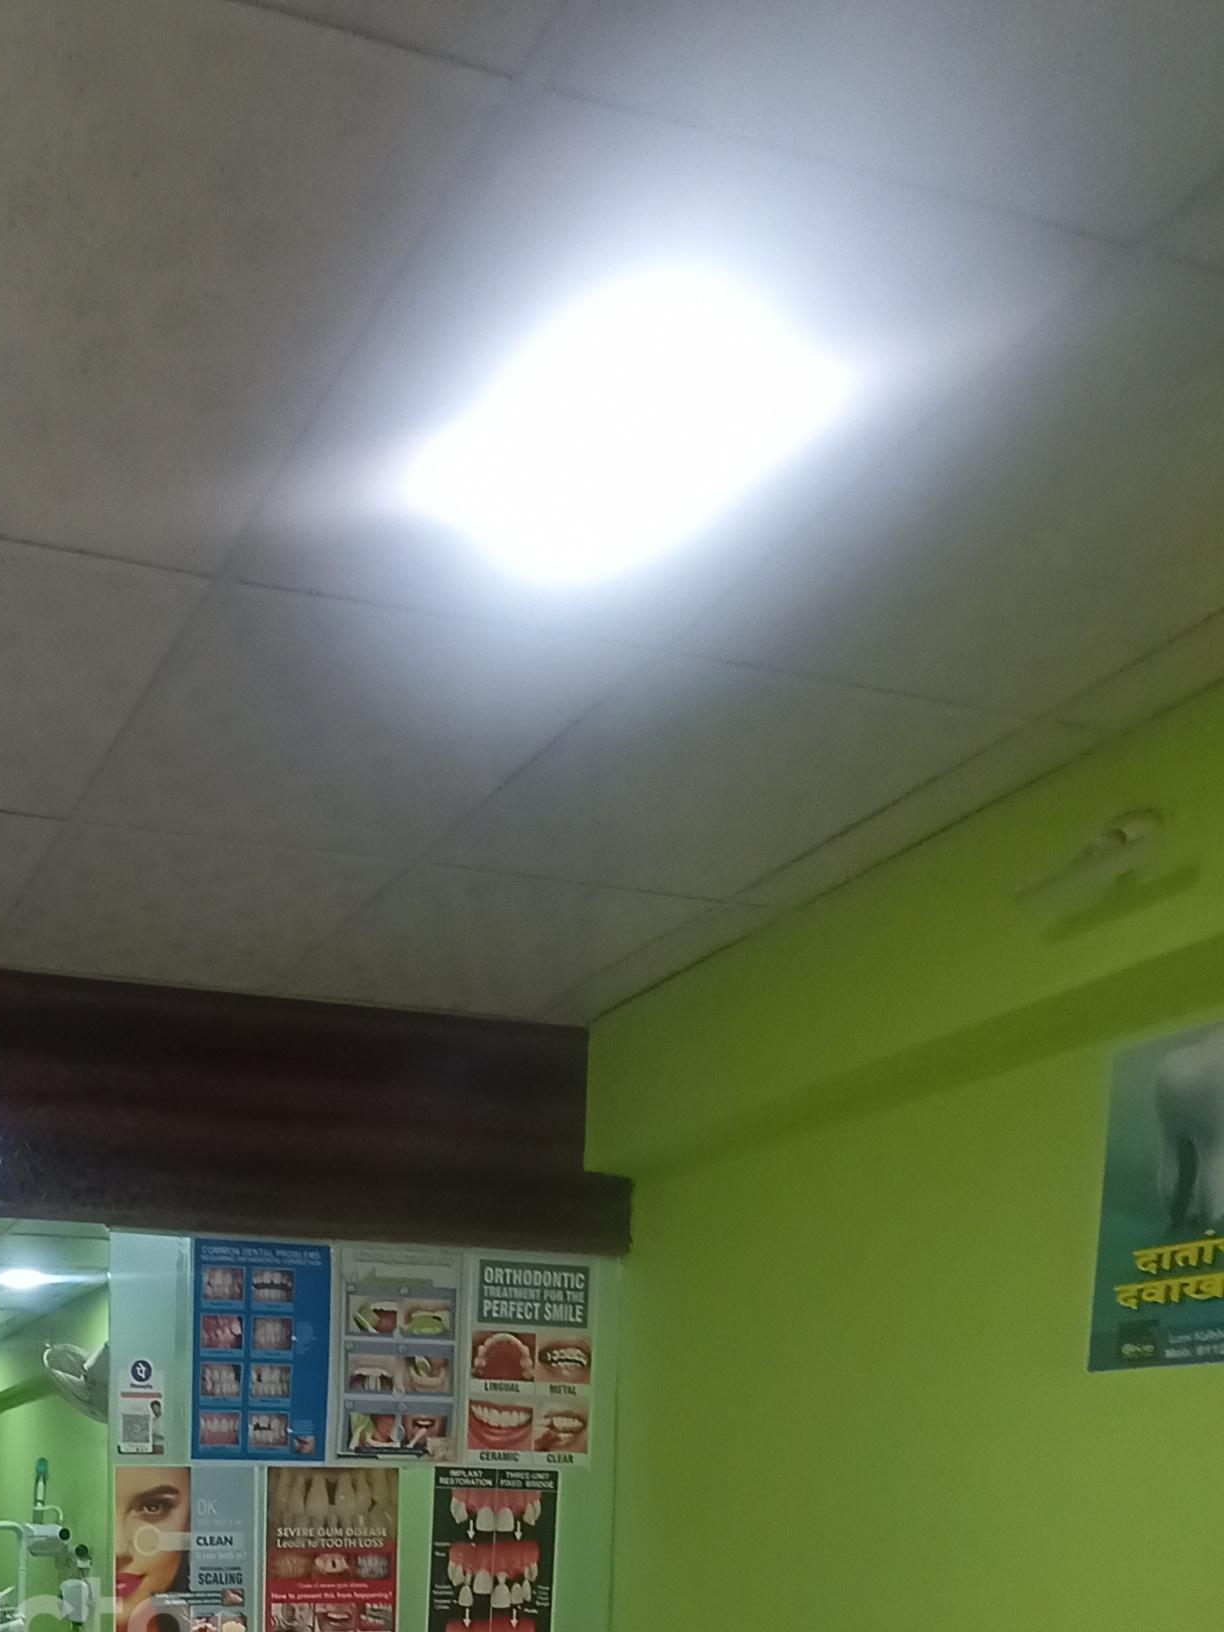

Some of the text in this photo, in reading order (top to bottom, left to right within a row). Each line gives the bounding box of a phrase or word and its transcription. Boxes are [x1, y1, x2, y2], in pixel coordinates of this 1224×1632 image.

[483, 1266, 586, 1290] ORTHODONTIC
[482, 1285, 541, 1301] TREATMENT
[482, 1299, 585, 1323] PERFECT SMILE
[484, 1382, 520, 1393] LINGUAL
[549, 1384, 577, 1396] METAL
[479, 1451, 520, 1462] CERAMIC
[546, 1453, 574, 1464] CLEAR
[276, 1527, 388, 1538] SEVERE GUM DISEASE
[196, 1535, 234, 1547] CLEAN
[320, 1538, 358, 1549] TOOTH
[359, 1538, 384, 1549] LOSS
[197, 1573, 243, 1585] SCALING
